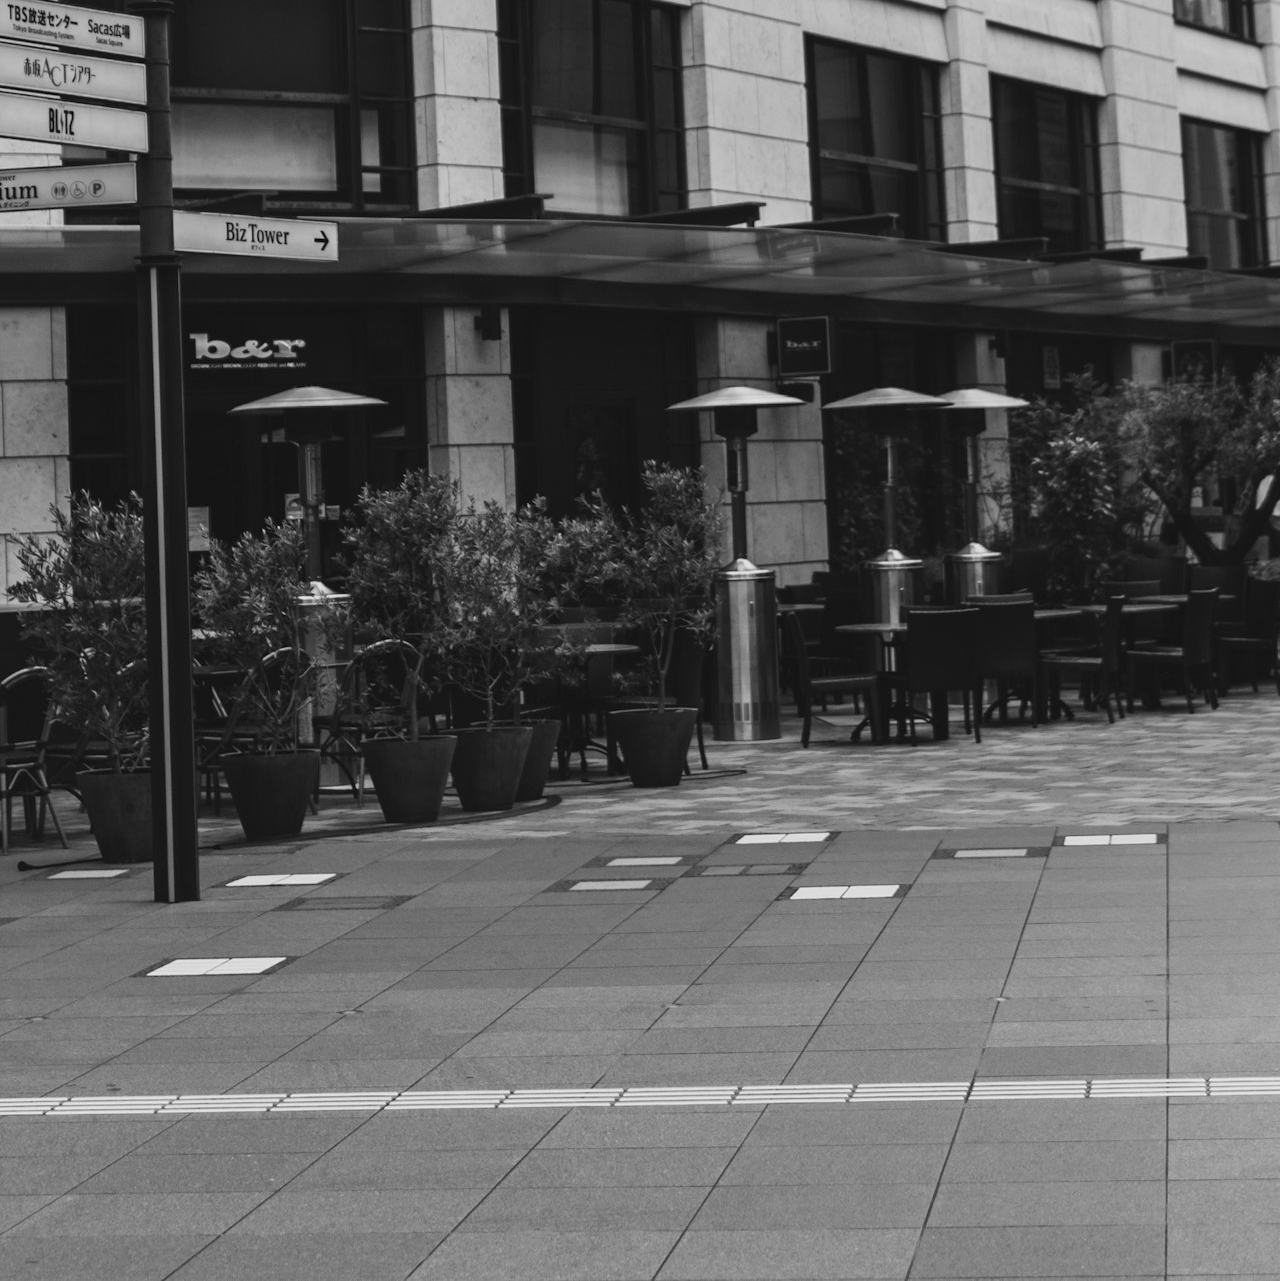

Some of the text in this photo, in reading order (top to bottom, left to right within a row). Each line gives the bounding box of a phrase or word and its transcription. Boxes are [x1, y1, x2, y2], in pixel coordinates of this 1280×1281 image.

[8, 3, 131, 40] TBS放送センター Sacas広場
[13, 23, 74, 41] Tokyo Broadcasting System
[95, 36, 123, 48] Sacas Square
[23, 56, 97, 87] 赤坂ACTシアター
[48, 107, 75, 136] BLITZ
[225, 221, 290, 245] Biz Tower
[189, 332, 306, 360] b&r
